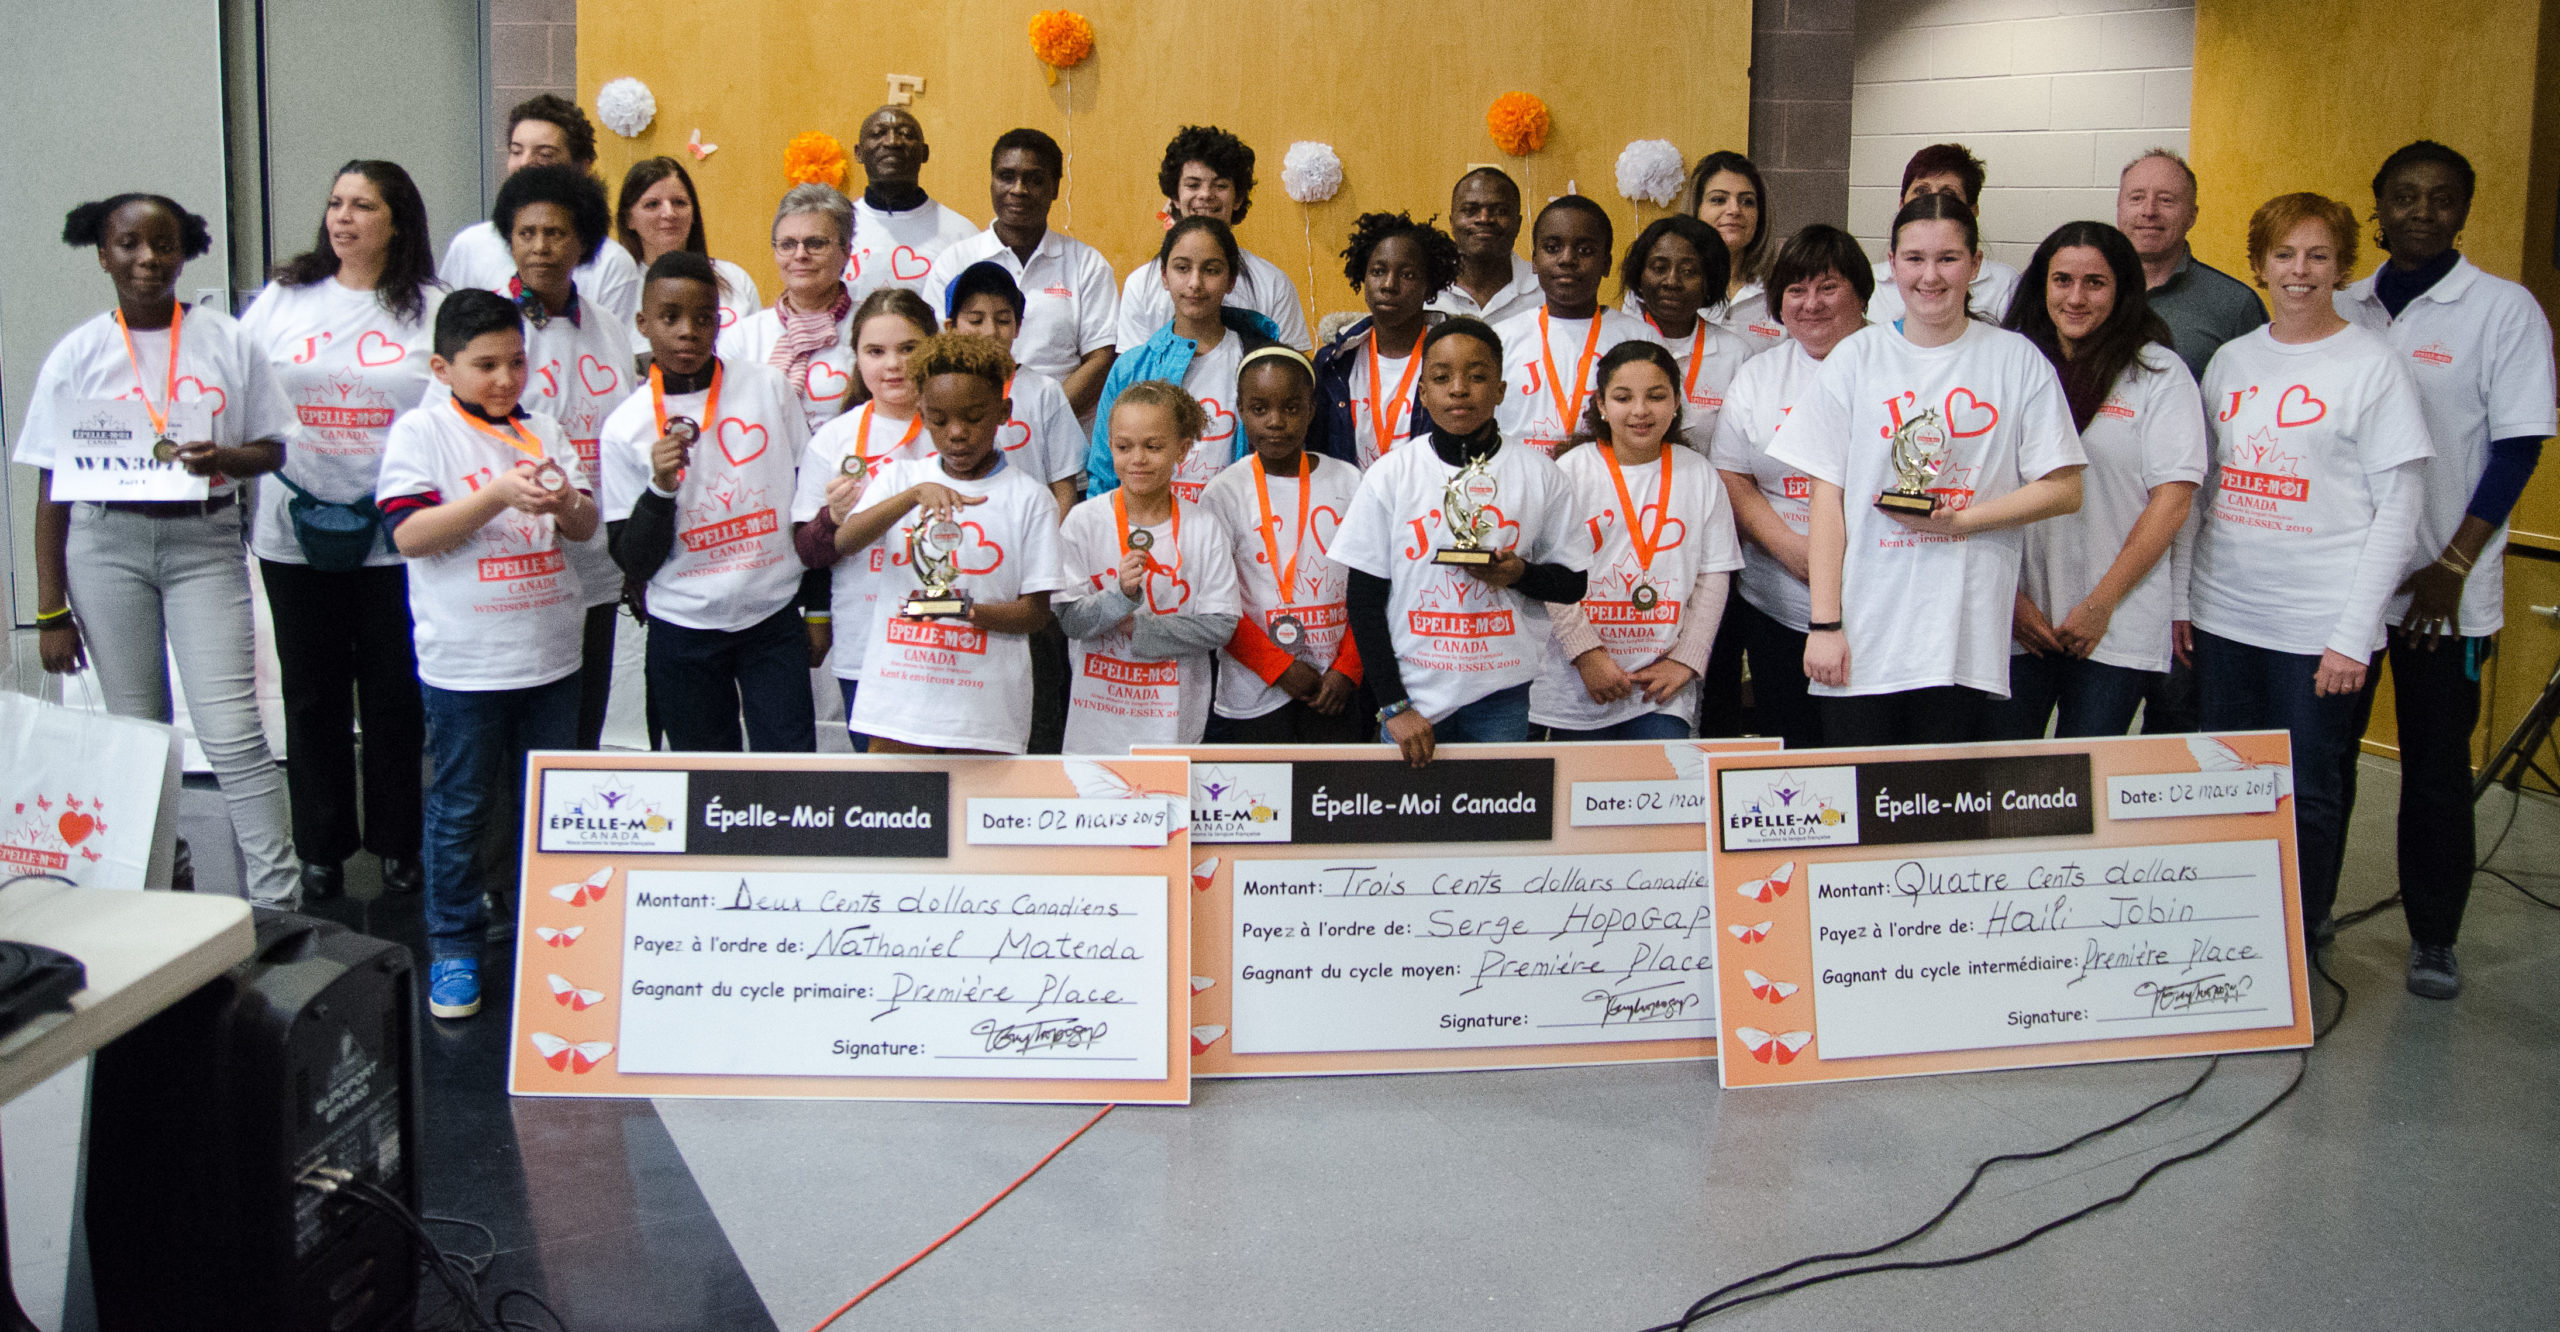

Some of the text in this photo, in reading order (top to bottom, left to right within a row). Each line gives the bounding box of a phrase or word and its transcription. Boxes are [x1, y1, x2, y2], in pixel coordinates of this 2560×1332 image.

[846, 248, 870, 282] J'
[293, 331, 332, 364] J'
[536, 359, 561, 398] J'
[2219, 385, 2259, 422] J'
[1880, 390, 1916, 439] J'
[320, 430, 369, 441] CANADA
[2228, 493, 2278, 512] CANADA
[1405, 509, 1442, 560] J'
[2286, 525, 2313, 534] 2019
[709, 540, 763, 559] CANADA
[1879, 538, 1904, 548] Kent
[1907, 537, 1915, 547] &
[1413, 613, 1511, 635] ÉPELLE-MOI
[1600, 627, 1655, 638] CANADA
[889, 621, 982, 650] ÉPELLE-MOI
[904, 649, 957, 666] CANADA
[1433, 640, 1489, 654] CANADA
[1089, 656, 1179, 683] ÉPELLE-MOI
[1497, 659, 1521, 669] 2019
[881, 668, 900, 679] Kent
[909, 673, 955, 685] environs
[957, 679, 984, 689] 2019
[1107, 684, 1160, 700] CANADA
[1073, 698, 1164, 718] WINDSOR-ESSEX
[1311, 785, 1537, 822] Épelle-Moi Canada
[1586, 796, 1632, 811] Date:
[1637, 792, 1663, 810] 02
[2121, 789, 2163, 804] Date:
[2170, 784, 2193, 800] 02
[2200, 783, 2238, 798] mars
[704, 795, 932, 832] Épelle-Moi Canada
[1875, 787, 2077, 822] Épelle-Moi Canada
[550, 814, 673, 833] ÉPELLE-MOI
[983, 810, 1165, 830] Date: 02 mars 2019
[1194, 823, 1244, 831] ANADA
[1730, 809, 1846, 829] ÉPELLE-MOI
[580, 831, 640, 840] CANADA
[1760, 827, 1816, 837] CANADA
[1243, 881, 1322, 896] Montant:
[1322, 866, 1406, 897] Trois
[1523, 866, 1613, 894] dollars
[1818, 883, 1890, 899] Montant:
[1895, 861, 2008, 907] Quatre
[2105, 857, 2198, 885] dollars
[637, 892, 716, 907] Montant:
[719, 878, 801, 911] Deux
[898, 886, 1001, 914] dollars
[1242, 923, 1295, 942] Payez
[1300, 922, 1310, 937] à
[1319, 922, 1376, 937] l'ordre
[1384, 921, 1412, 936] de:
[1427, 910, 1528, 944] Serge
[1819, 925, 1866, 944] Payez
[1873, 922, 1882, 938] à
[1890, 922, 1942, 937] l'ordre
[1949, 919, 1975, 933] de:
[2101, 895, 2194, 929] Jobin
[634, 924, 1144, 964] Payez à l'ordre de: Nathaniel Matenda
[1242, 965, 1313, 984] Gagnant
[1321, 964, 1341, 979] du
[1350, 963, 1393, 982] cycle
[1401, 964, 1461, 982] moyen:
[1615, 943, 1712, 985] Place
[1822, 967, 1888, 987] Gagnant
[1895, 965, 1914, 980] du
[1920, 962, 1961, 982] cycle
[1969, 956, 2079, 974] intermédiaire:
[2181, 935, 2257, 975] Place
[632, 980, 703, 1000] Gagnant
[711, 981, 732, 997] du
[740, 981, 785, 1002] cycle
[794, 983, 874, 1002] primaire:
[1026, 974, 1123, 1013] Place
[1440, 1014, 1528, 1032] Signature:
[2008, 1009, 2088, 1029] Signature:
[832, 1040, 925, 1059] Signature:
